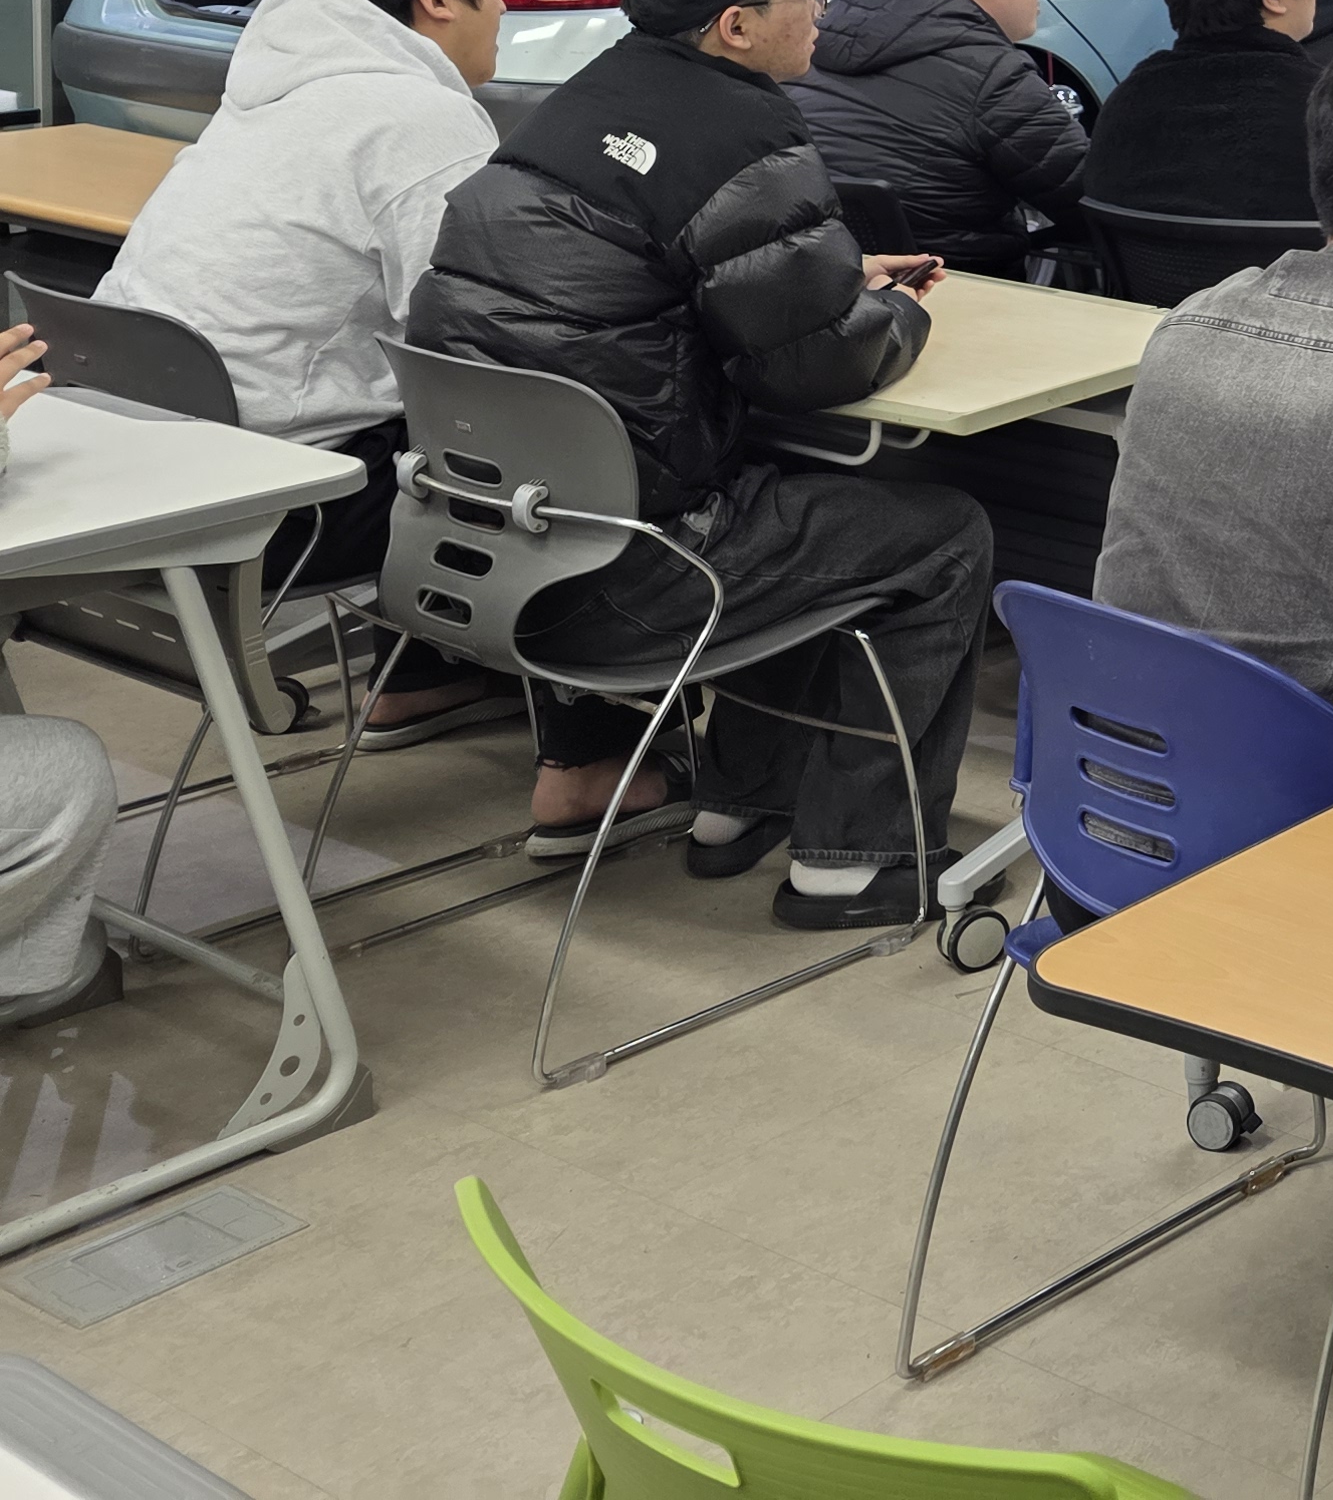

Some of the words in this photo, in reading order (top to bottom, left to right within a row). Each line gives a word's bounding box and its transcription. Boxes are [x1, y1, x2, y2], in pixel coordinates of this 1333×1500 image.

[602, 133, 639, 156] NORTH
[624, 131, 647, 149] THE
[603, 145, 632, 164] FACE
